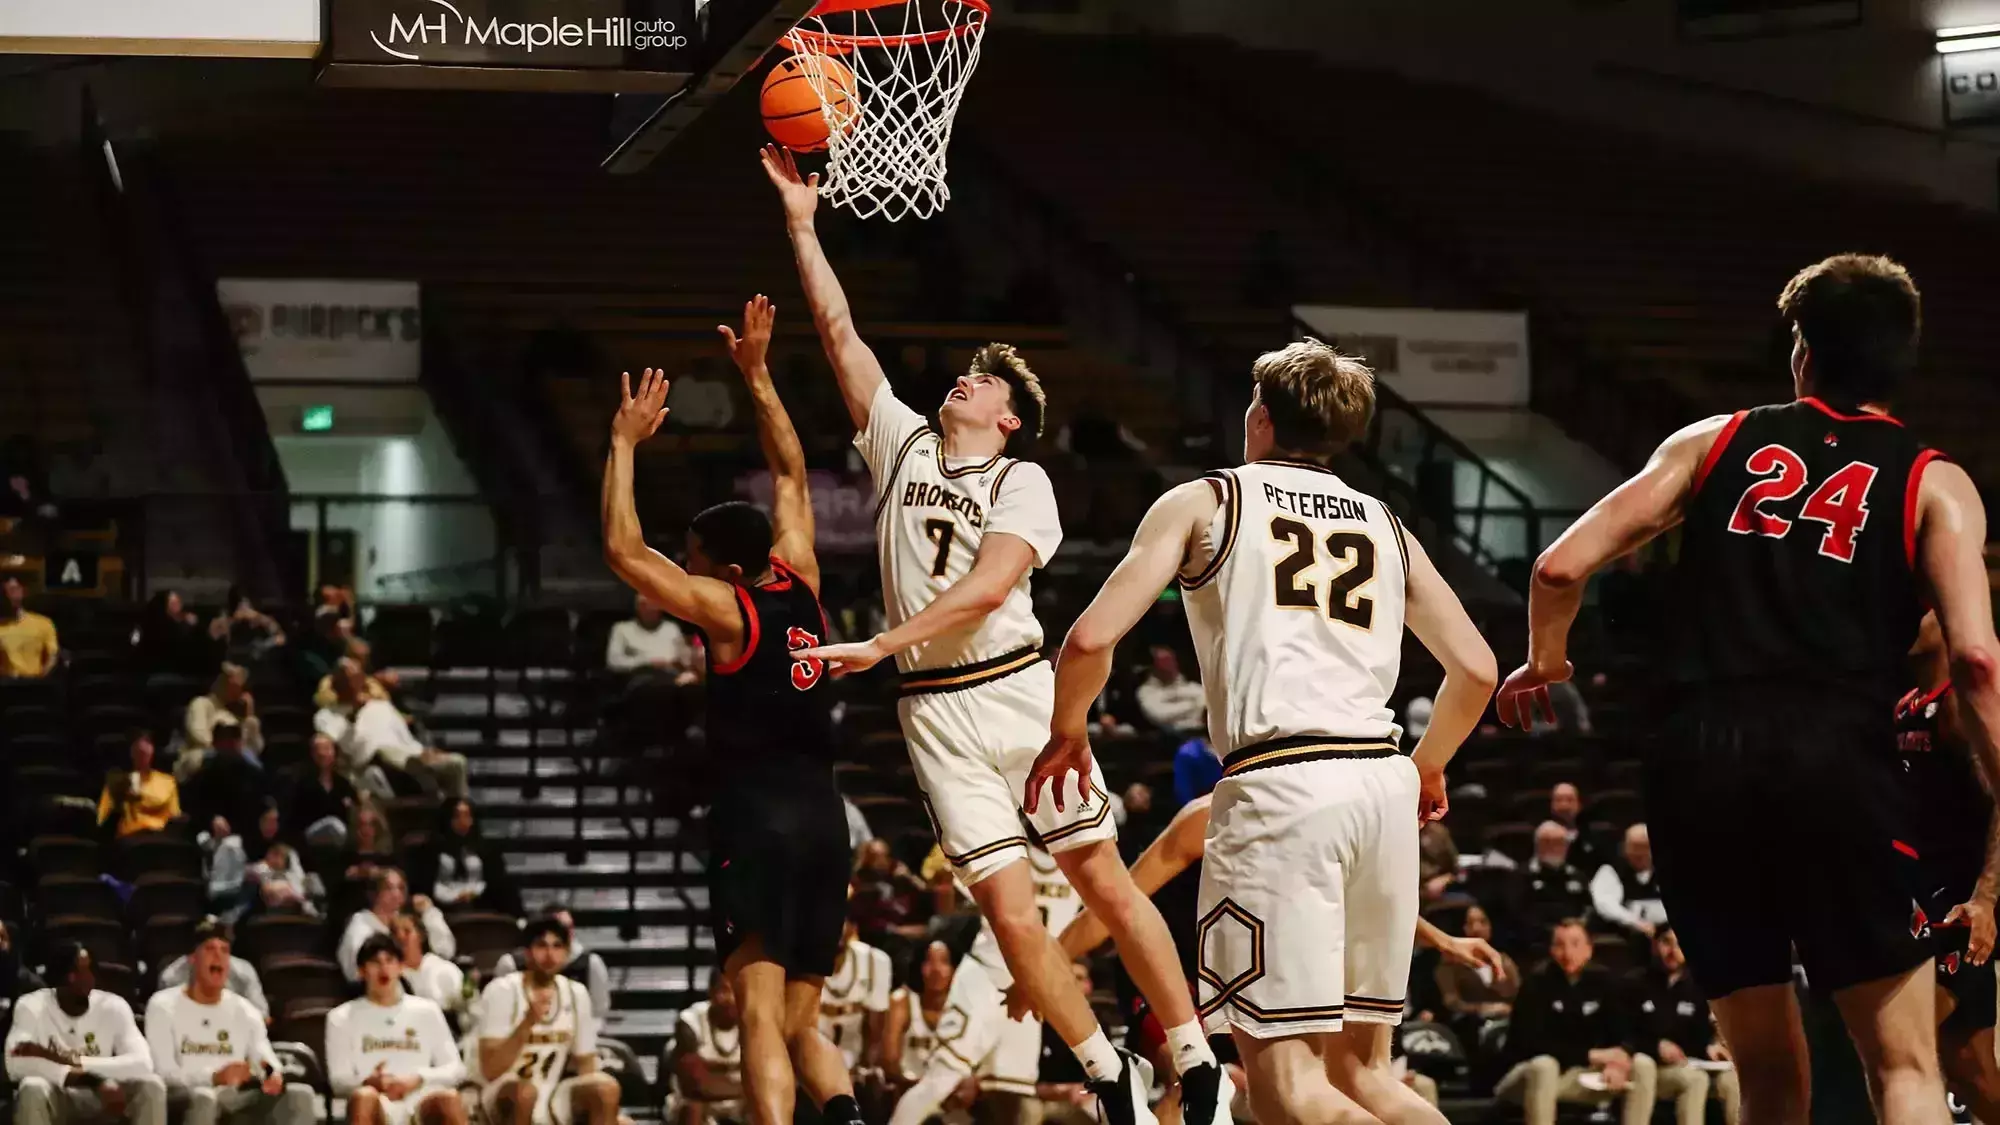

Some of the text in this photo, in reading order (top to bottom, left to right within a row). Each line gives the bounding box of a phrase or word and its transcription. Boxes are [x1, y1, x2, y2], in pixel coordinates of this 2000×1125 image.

[634, 18, 675, 33] auto
[634, 33, 687, 50] group
[1263, 482, 1368, 522] PETERSON
[1728, 444, 1879, 563] 24
[61, 558, 82, 584] A
[925, 518, 955, 577] 7
[1268, 513, 1376, 633] 22
[787, 626, 824, 691] 3
